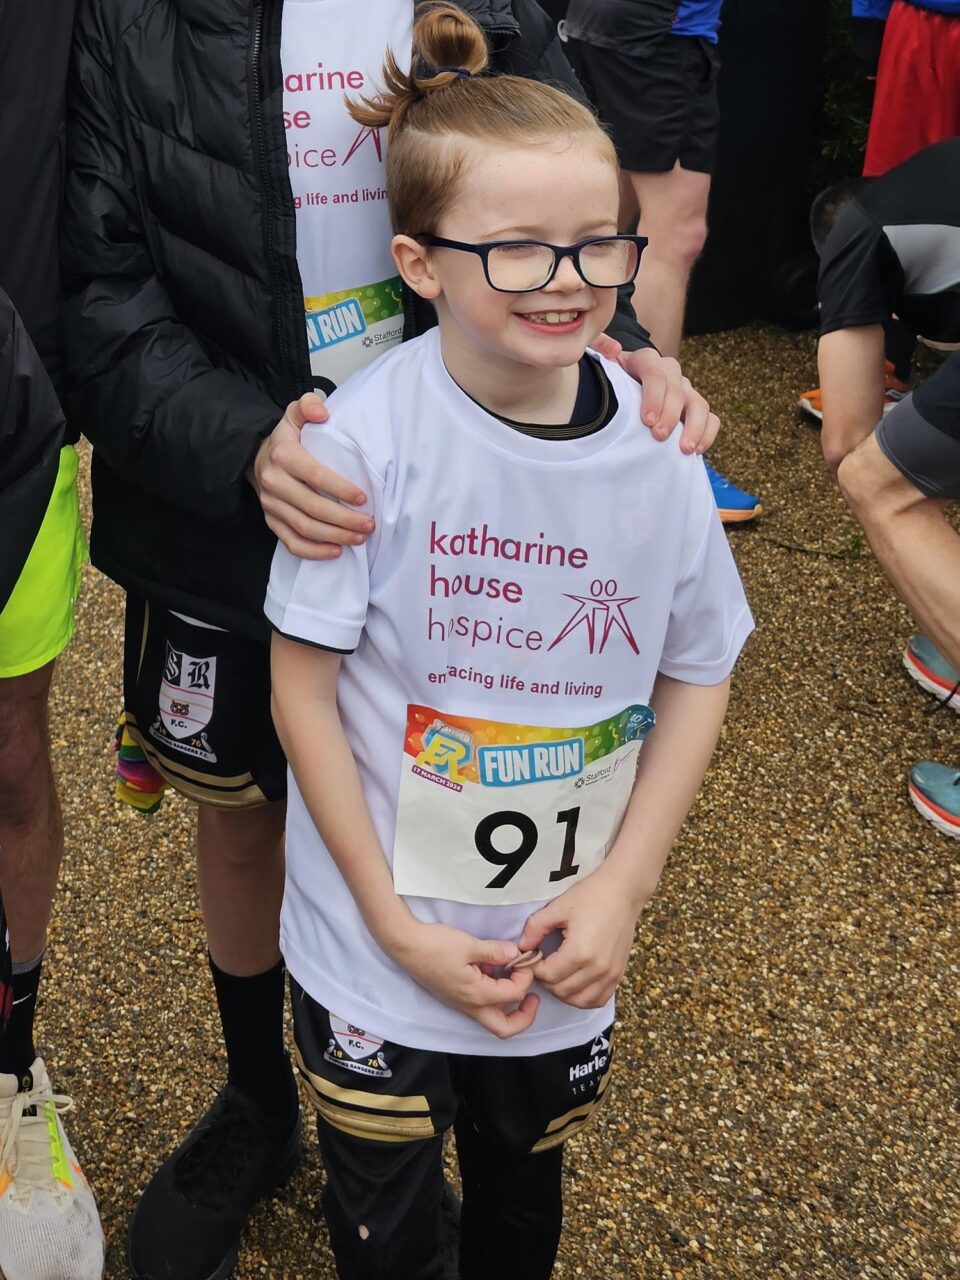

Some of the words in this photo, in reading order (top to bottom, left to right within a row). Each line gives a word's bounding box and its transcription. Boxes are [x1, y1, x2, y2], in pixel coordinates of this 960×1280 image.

[283, 63, 364, 92] arine
[306, 191, 328, 206] life
[333, 190, 358, 204] and
[362, 187, 387, 201] livin
[317, 303, 362, 344] RUN
[374, 327, 402, 342] Stafford
[430, 521, 588, 569] katharine
[430, 564, 523, 603] house
[500, 674, 525, 691] life
[530, 680, 560, 695] and
[564, 681, 603, 698] living
[171, 718, 188, 729] F.C.
[484, 748, 529, 783] FUN
[533, 742, 580, 780] RUN
[413, 766, 421, 774] 17
[420, 770, 446, 785] MARCH
[446, 782, 461, 791] 2024
[474, 806, 581, 889] 91
[348, 1039, 364, 1050] F.C.
[333, 1049, 343, 1058] 18
[367, 1058, 378, 1067] 76
[350, 1063, 375, 1075] RANGERS
[569, 1055, 607, 1082] Harle
